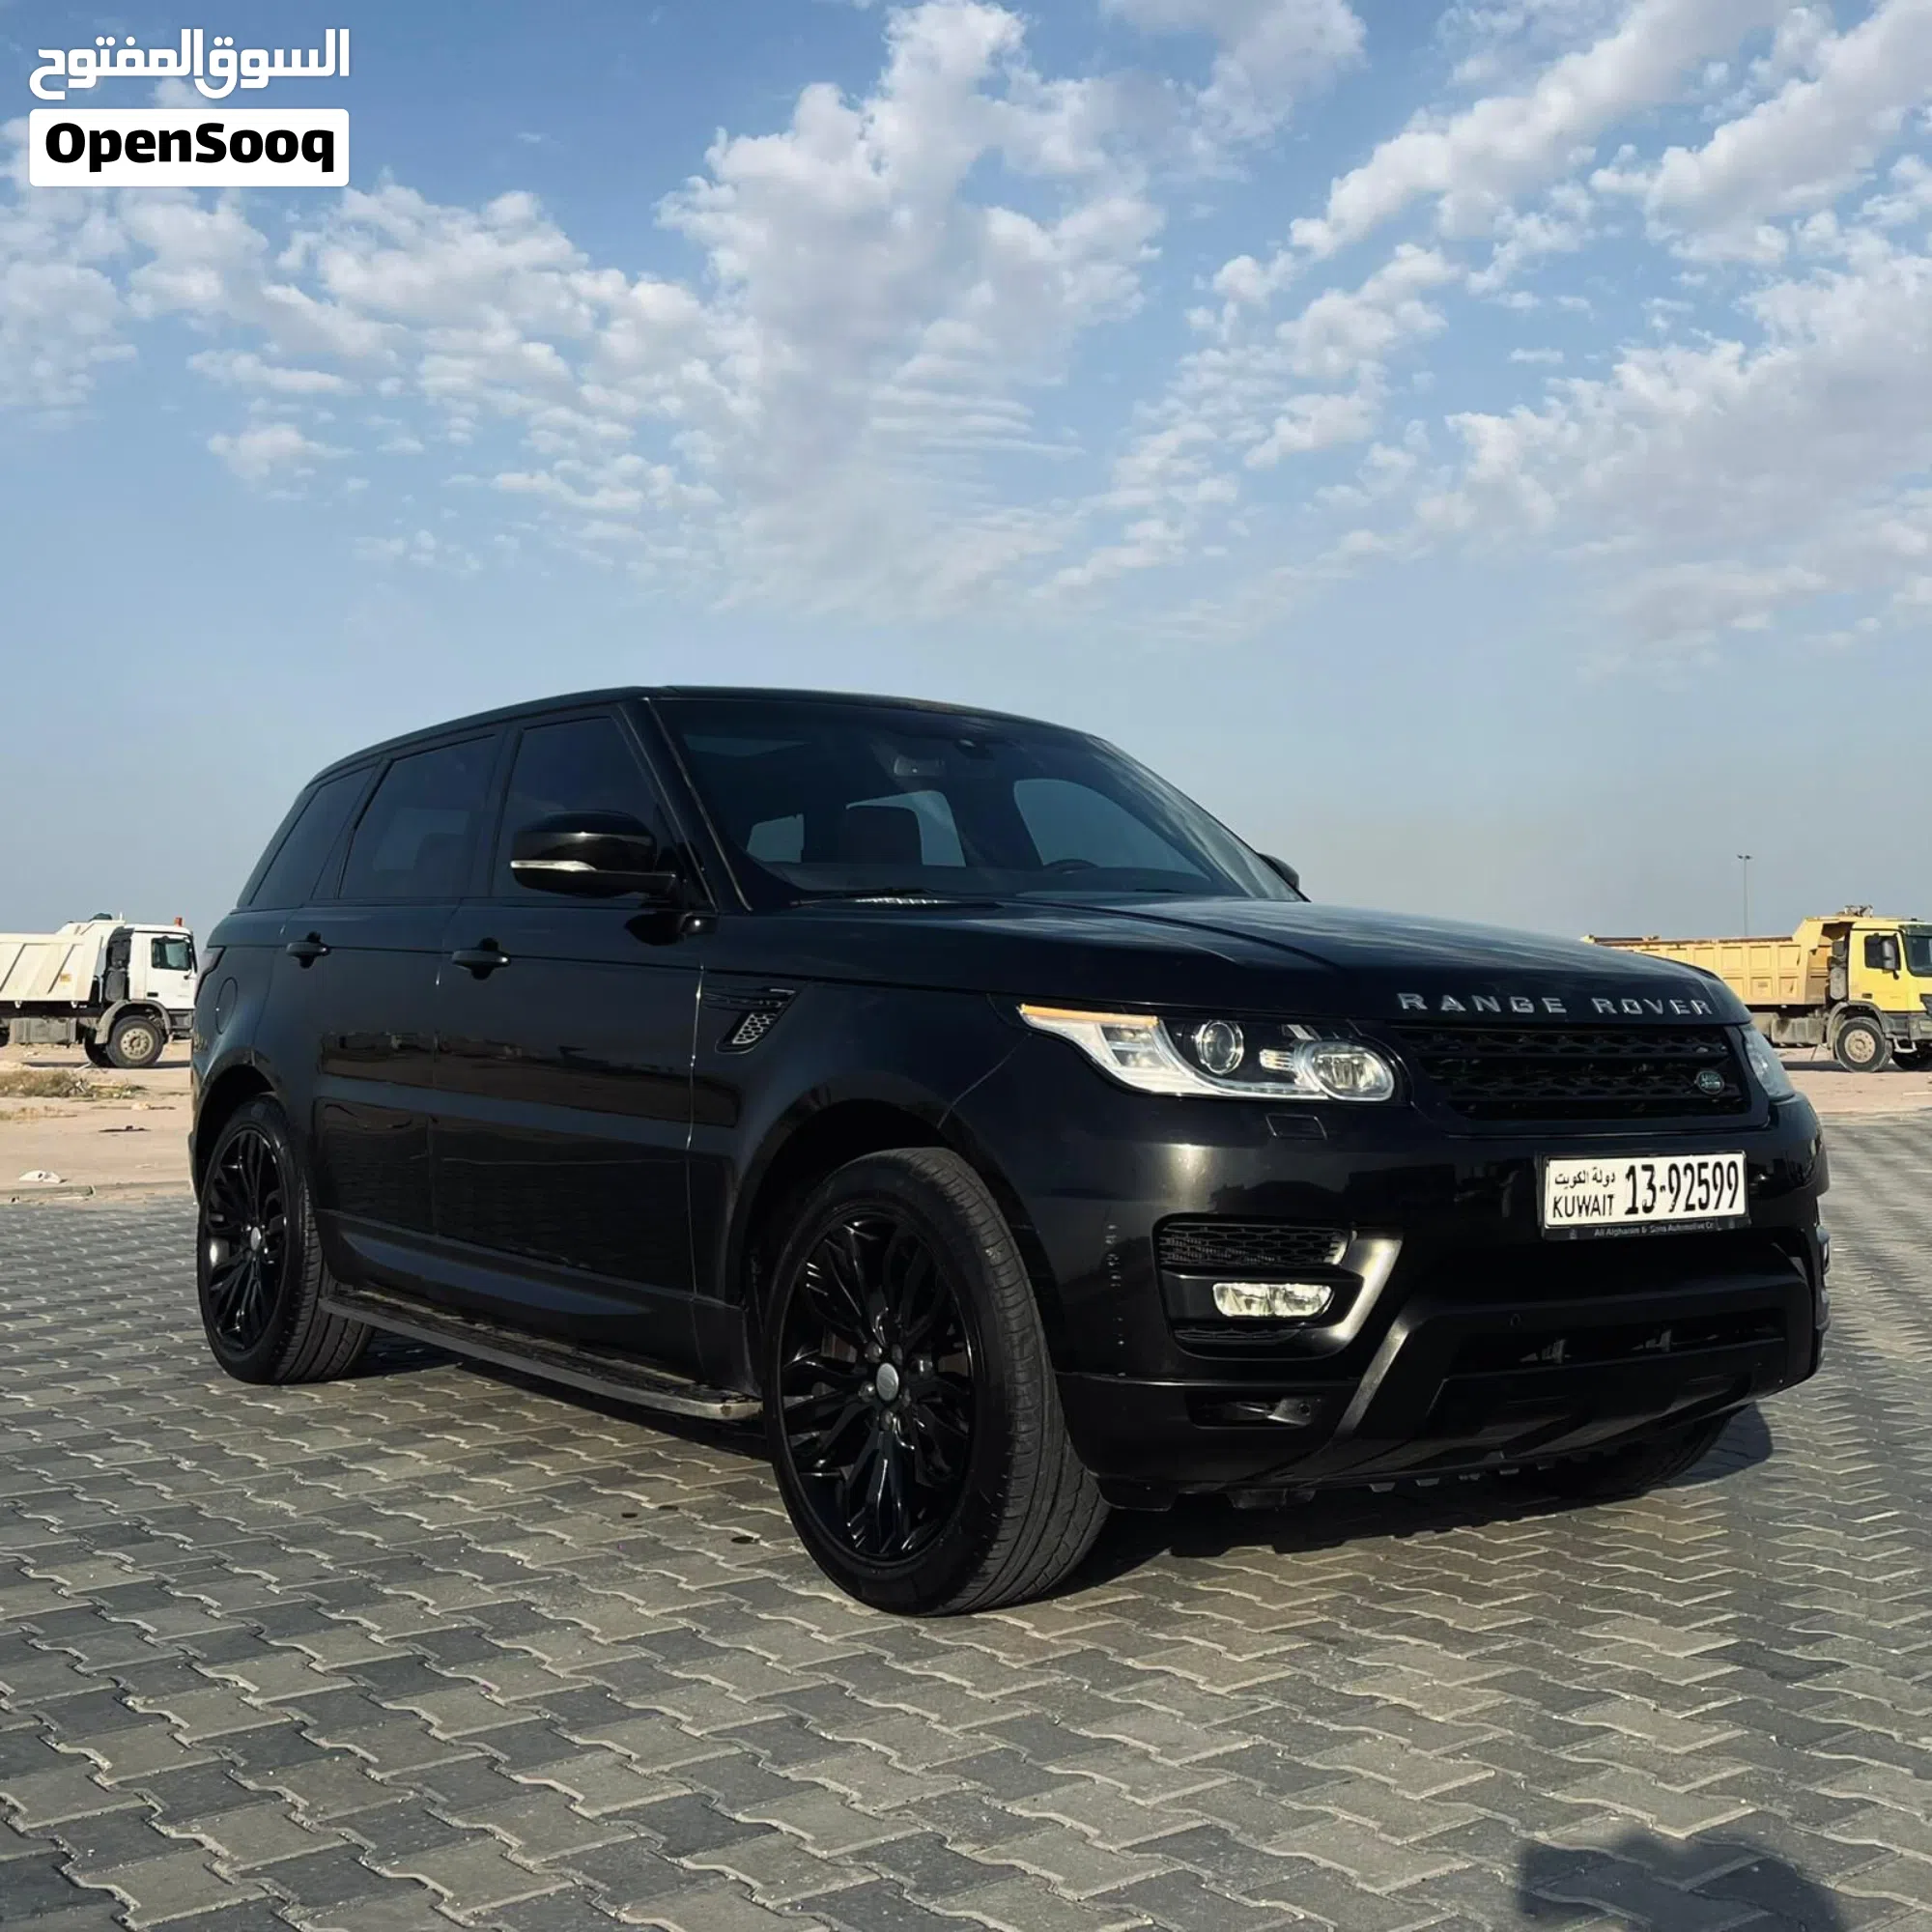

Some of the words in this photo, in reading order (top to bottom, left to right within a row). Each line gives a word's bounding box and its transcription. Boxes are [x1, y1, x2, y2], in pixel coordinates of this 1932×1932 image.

[1397, 993, 1568, 1015] RANGE
[1592, 997, 1714, 1015] ROVER
[1554, 1169, 1590, 1190] الكويت
[1592, 1166, 1616, 1188] دولة
[1624, 1160, 1740, 1215] 13-92599
[1552, 1194, 1615, 1218] KUWAIT
